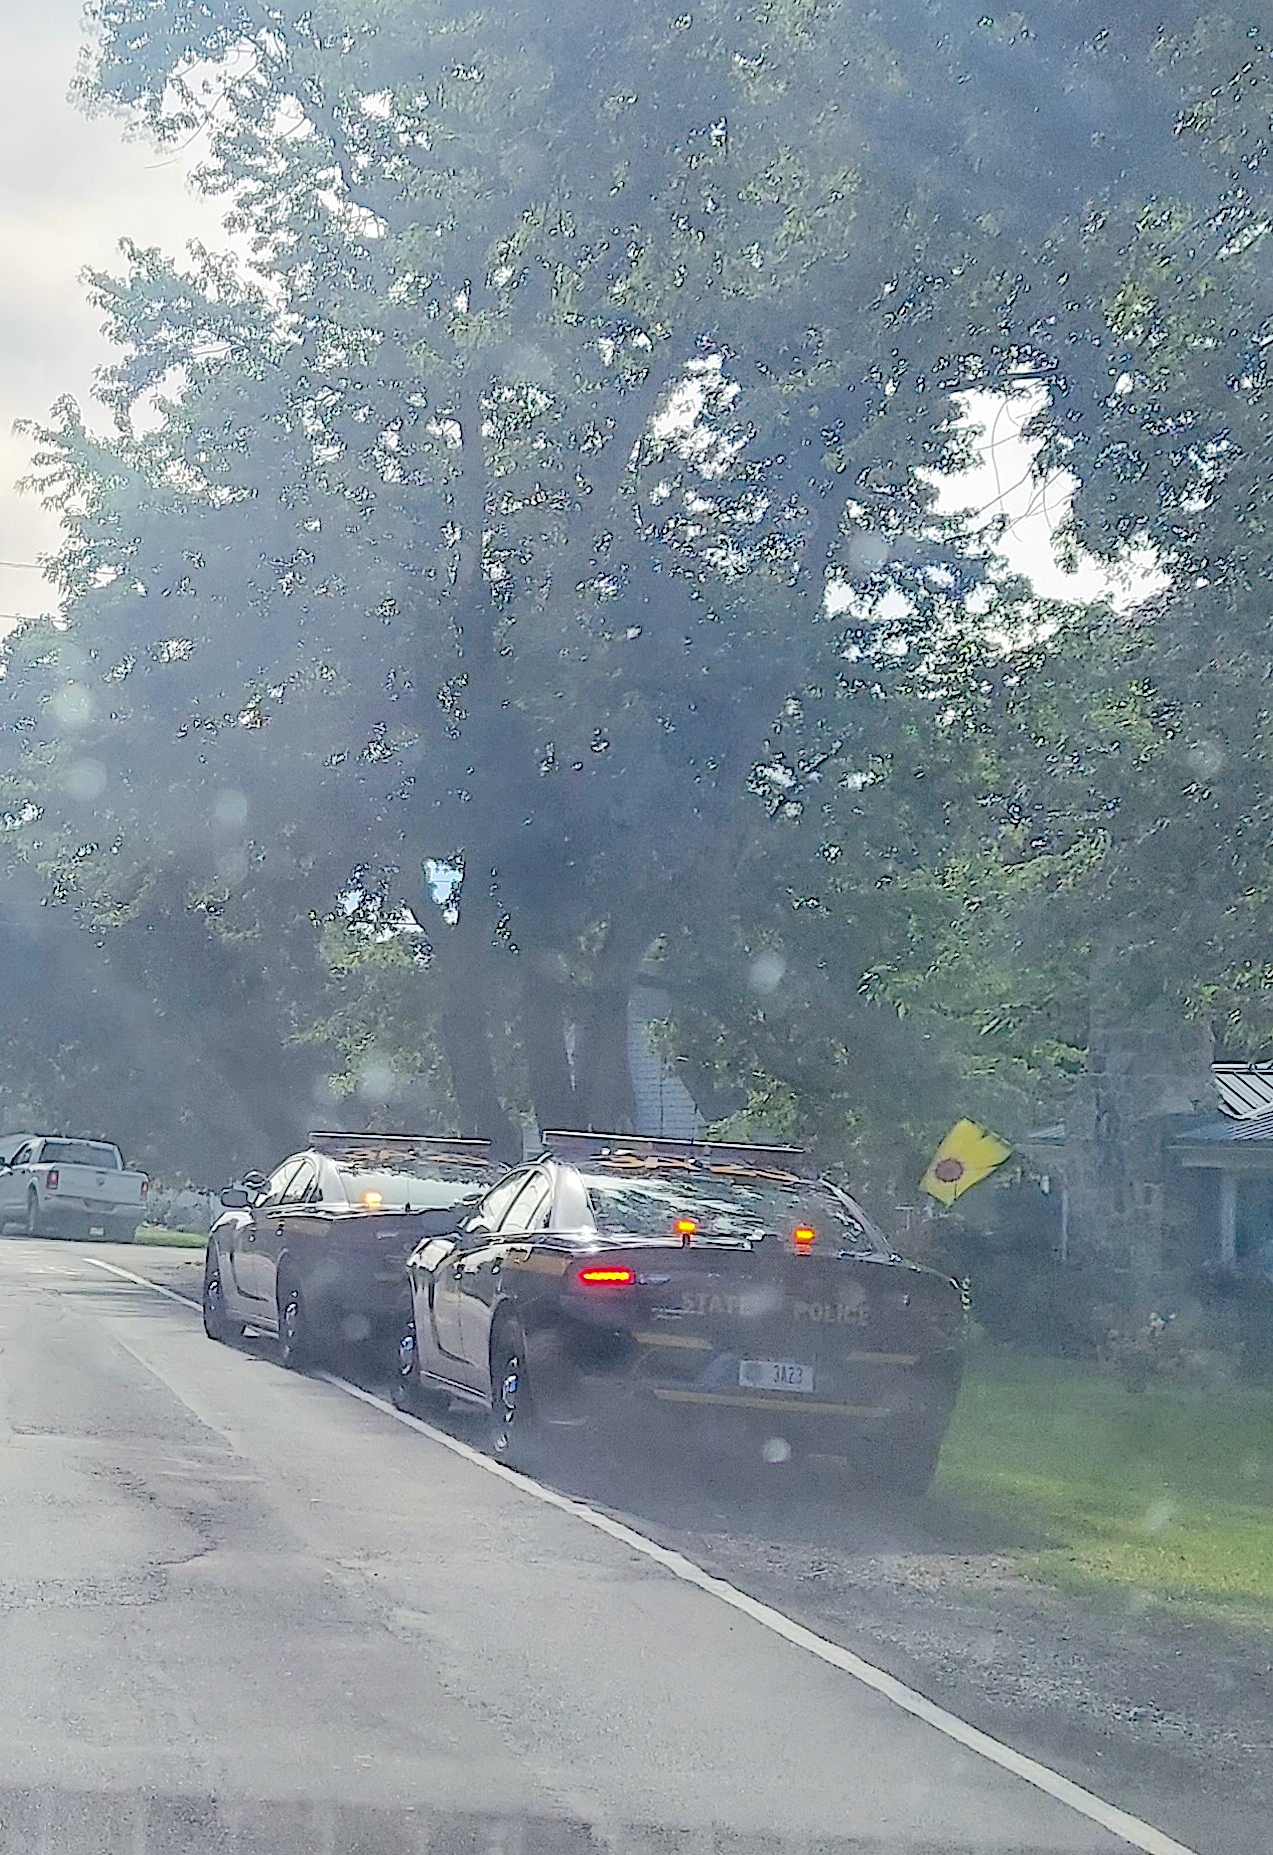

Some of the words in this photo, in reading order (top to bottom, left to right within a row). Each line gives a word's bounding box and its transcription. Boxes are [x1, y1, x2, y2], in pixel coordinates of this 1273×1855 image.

[682, 1292, 751, 1317] STATE
[792, 1300, 869, 1327] POLICE
[773, 1364, 804, 1385] 3A23
